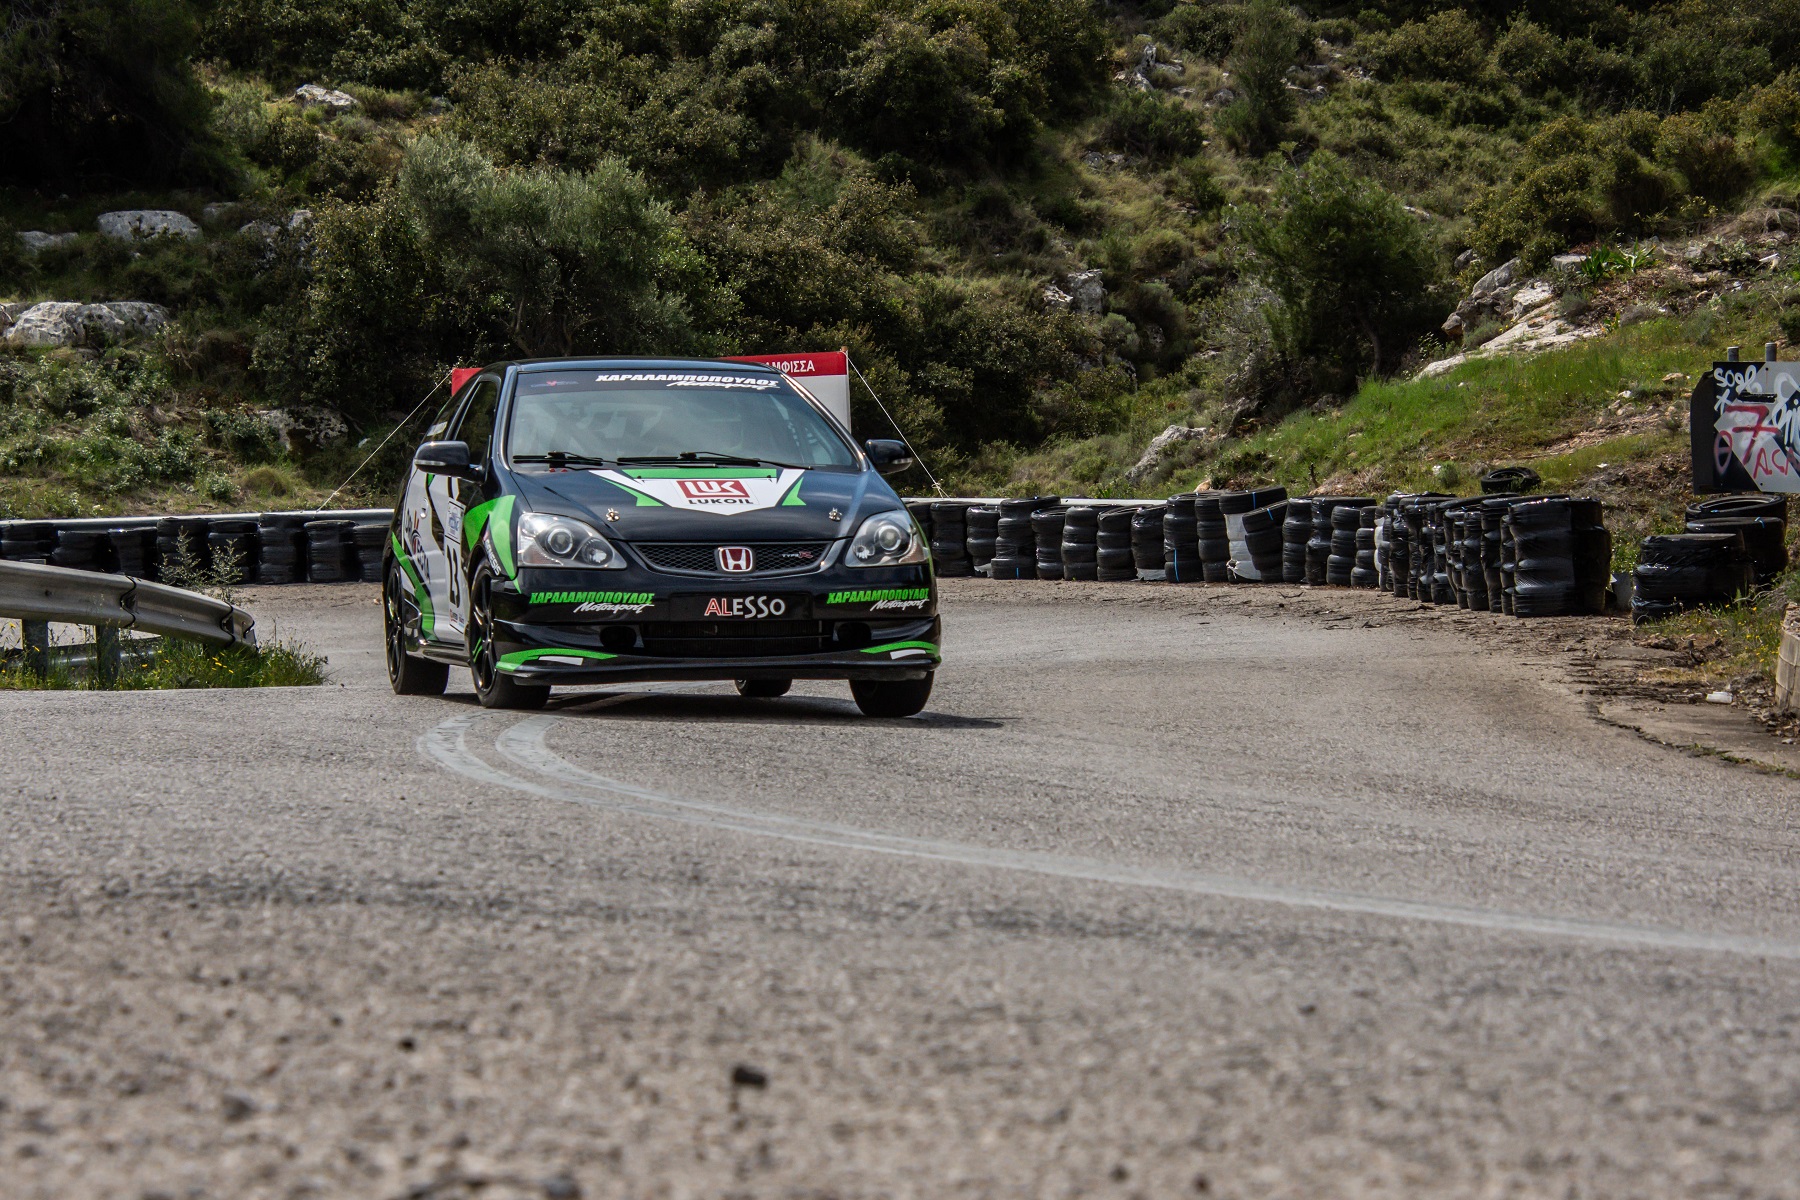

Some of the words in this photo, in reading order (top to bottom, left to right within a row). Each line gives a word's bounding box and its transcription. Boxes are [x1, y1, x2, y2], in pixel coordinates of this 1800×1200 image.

[529, 592, 655, 604] ΧΑΡΑΛΑΜΠΟΠΟΥΛΟΣ
[827, 588, 929, 604] ΧΑΡΑΛΑΜΠΟΠΟΥΛΟΣ
[573, 602, 655, 614] Motorsport
[704, 595, 786, 619] ALESSO
[869, 598, 930, 612] Motorsport
